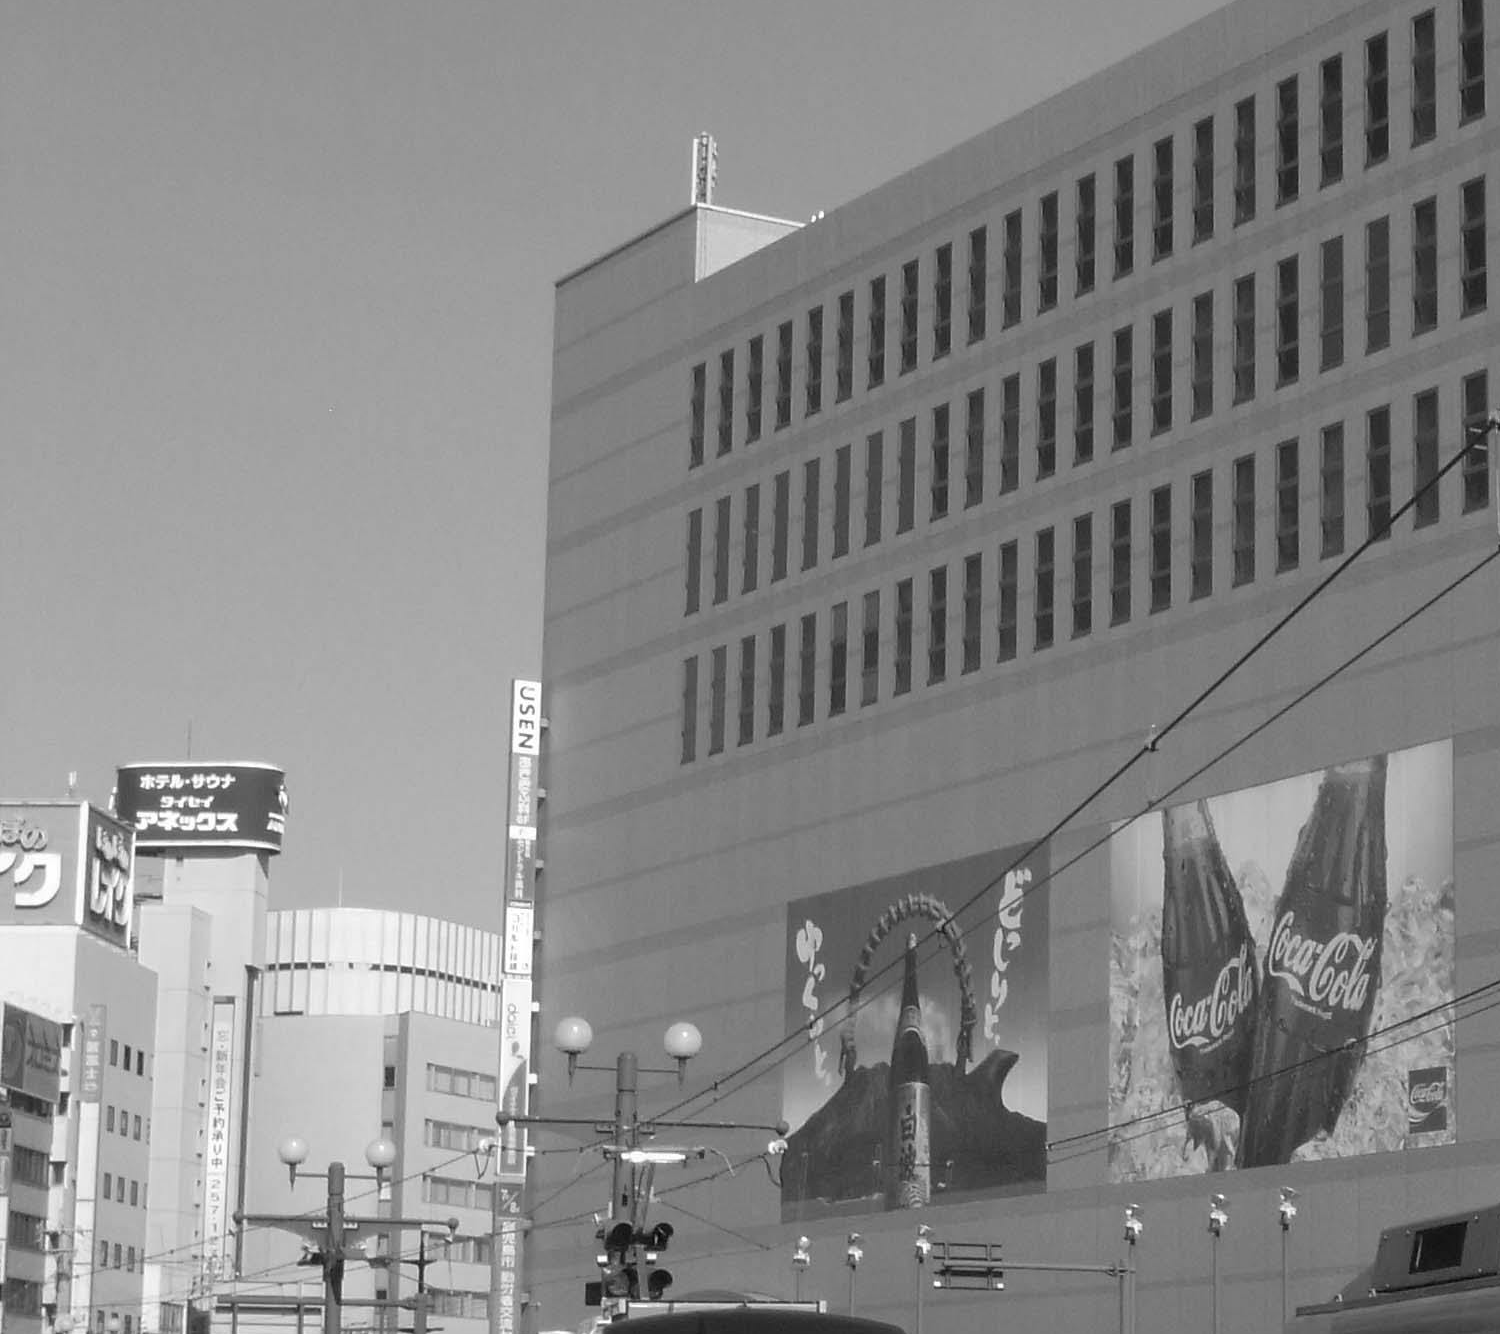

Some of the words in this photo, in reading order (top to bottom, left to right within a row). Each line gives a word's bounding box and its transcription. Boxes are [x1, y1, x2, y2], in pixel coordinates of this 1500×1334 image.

[518, 686, 536, 749] USEN
[140, 773, 236, 790] ホテル・サウナ
[160, 795, 215, 809] タイセイ
[134, 810, 239, 832] アネックス
[1269, 911, 1378, 1011] Coca-Cola
[1170, 942, 1253, 1049] Coca-Cola
